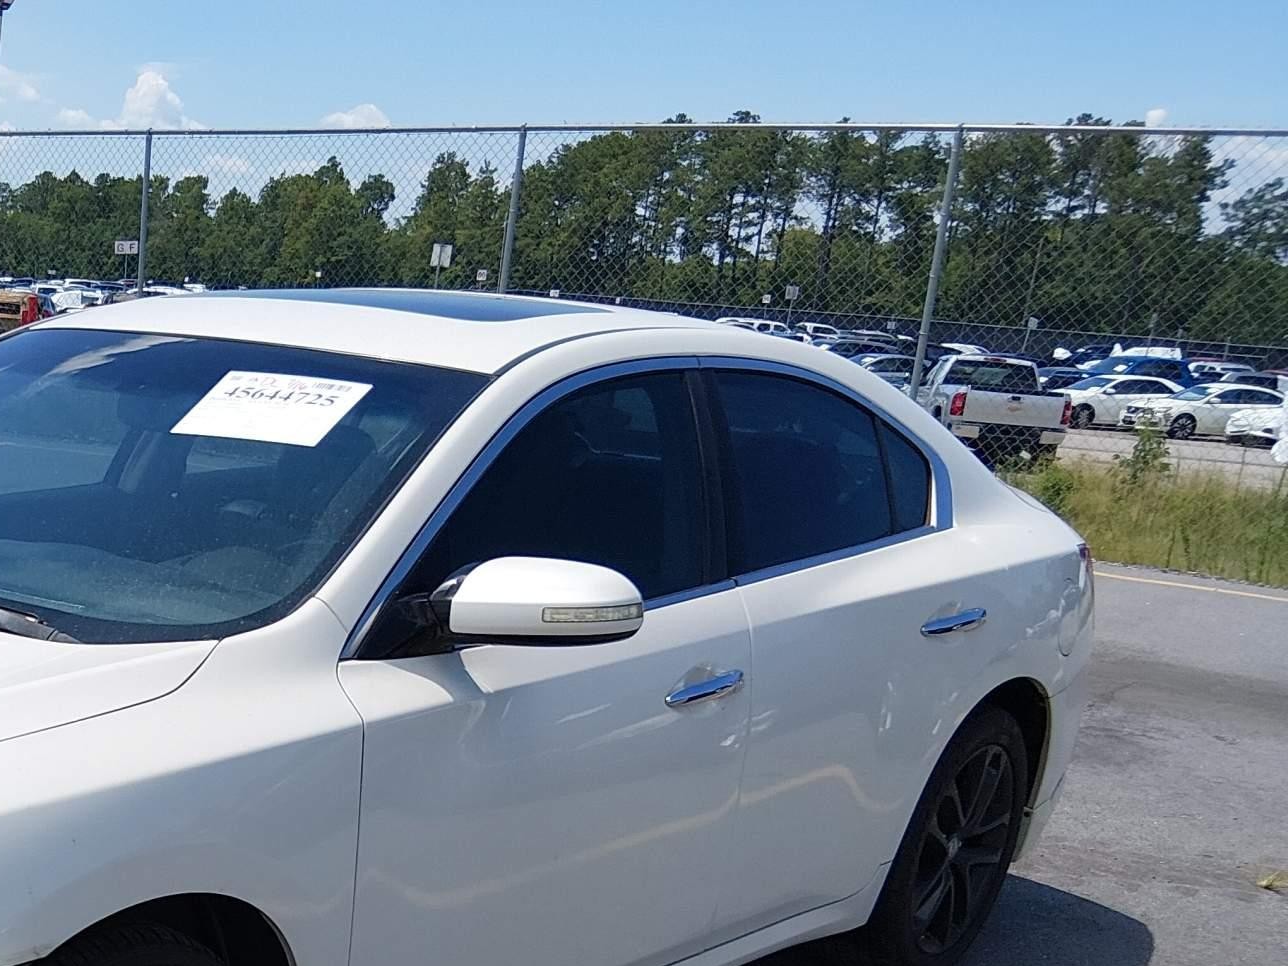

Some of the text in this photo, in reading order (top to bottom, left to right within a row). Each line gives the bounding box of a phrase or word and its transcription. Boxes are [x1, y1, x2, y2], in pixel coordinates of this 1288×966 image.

[117, 243, 136, 252] G F
[224, 386, 340, 407] 45644725
